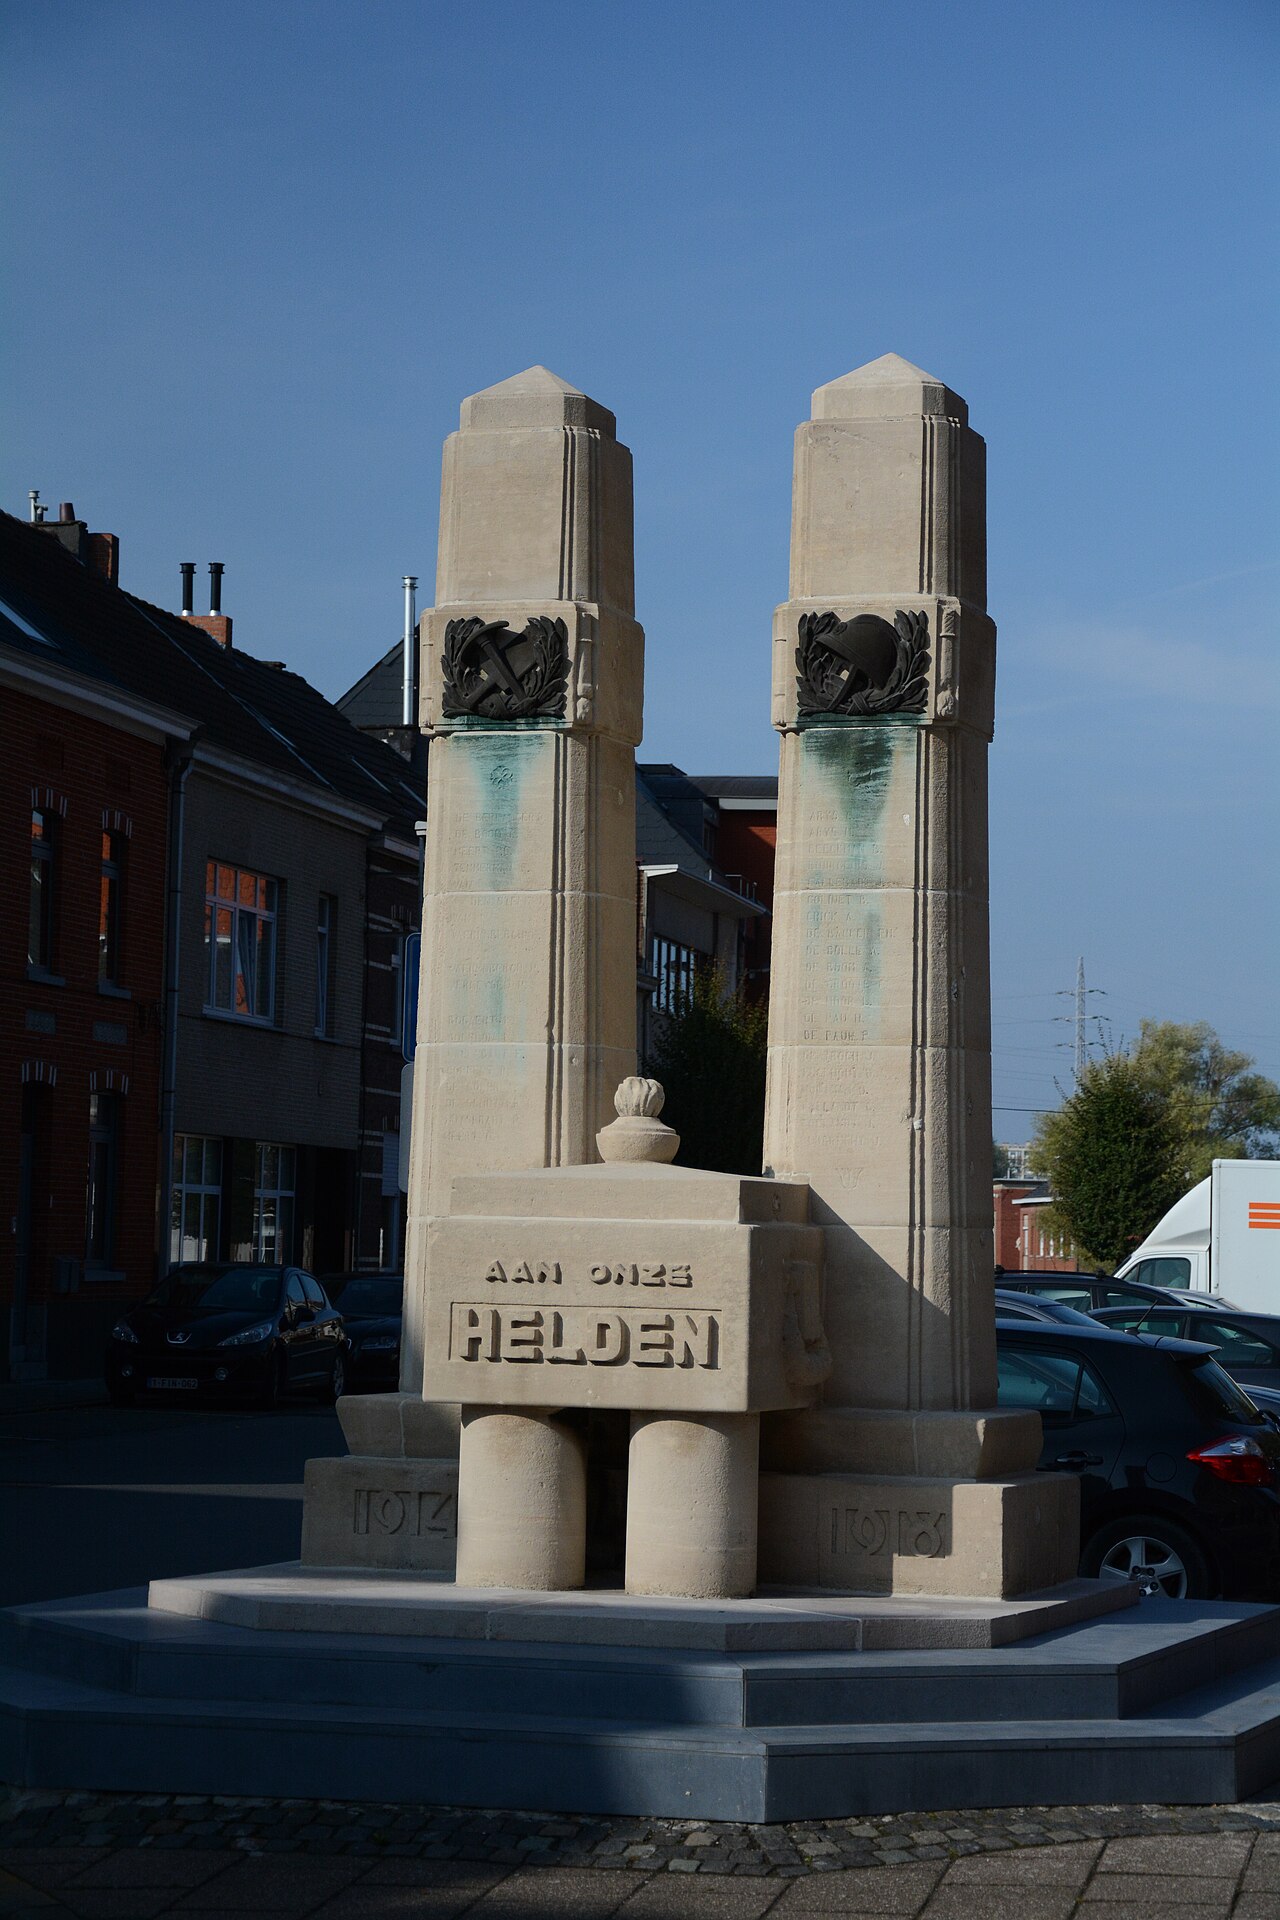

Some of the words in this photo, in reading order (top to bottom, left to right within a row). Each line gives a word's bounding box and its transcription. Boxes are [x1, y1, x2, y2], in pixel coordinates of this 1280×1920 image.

[486, 1259, 563, 1285] AAN
[590, 1262, 694, 1289] ONZE
[457, 1307, 721, 1370] HELDEN
[831, 1507, 946, 1559] 1918
